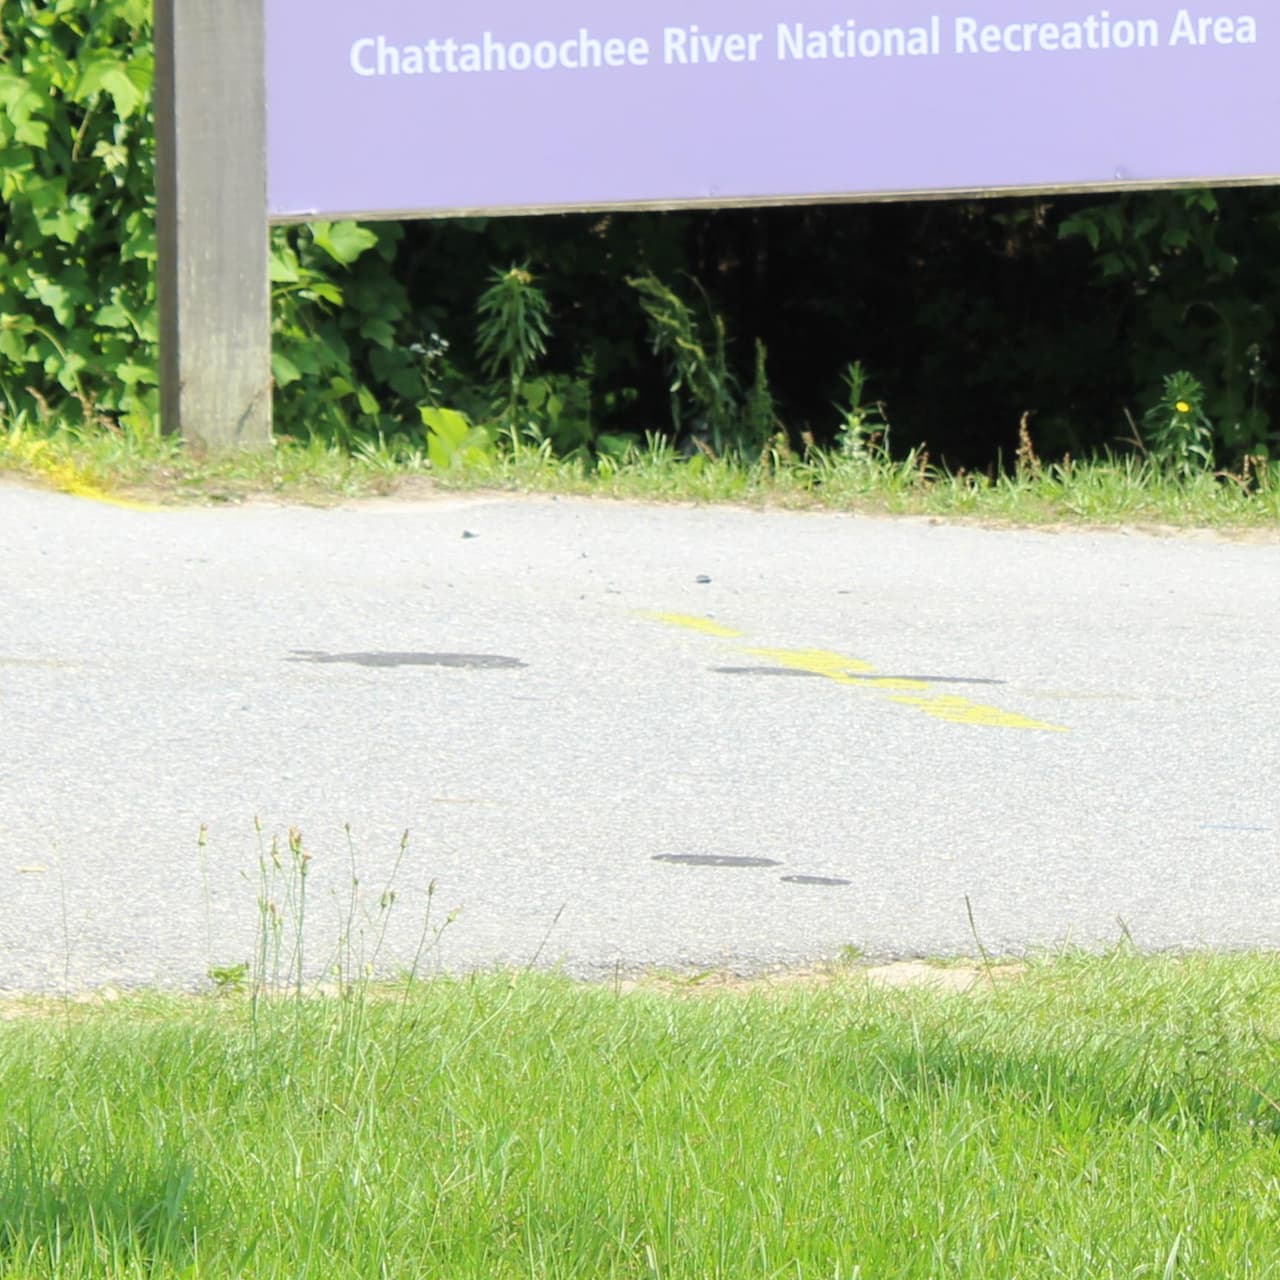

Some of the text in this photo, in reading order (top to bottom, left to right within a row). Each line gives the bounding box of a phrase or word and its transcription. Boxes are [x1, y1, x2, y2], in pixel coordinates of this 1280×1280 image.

[349, 9, 1257, 76] Chattahoochee River National Recreation Area
